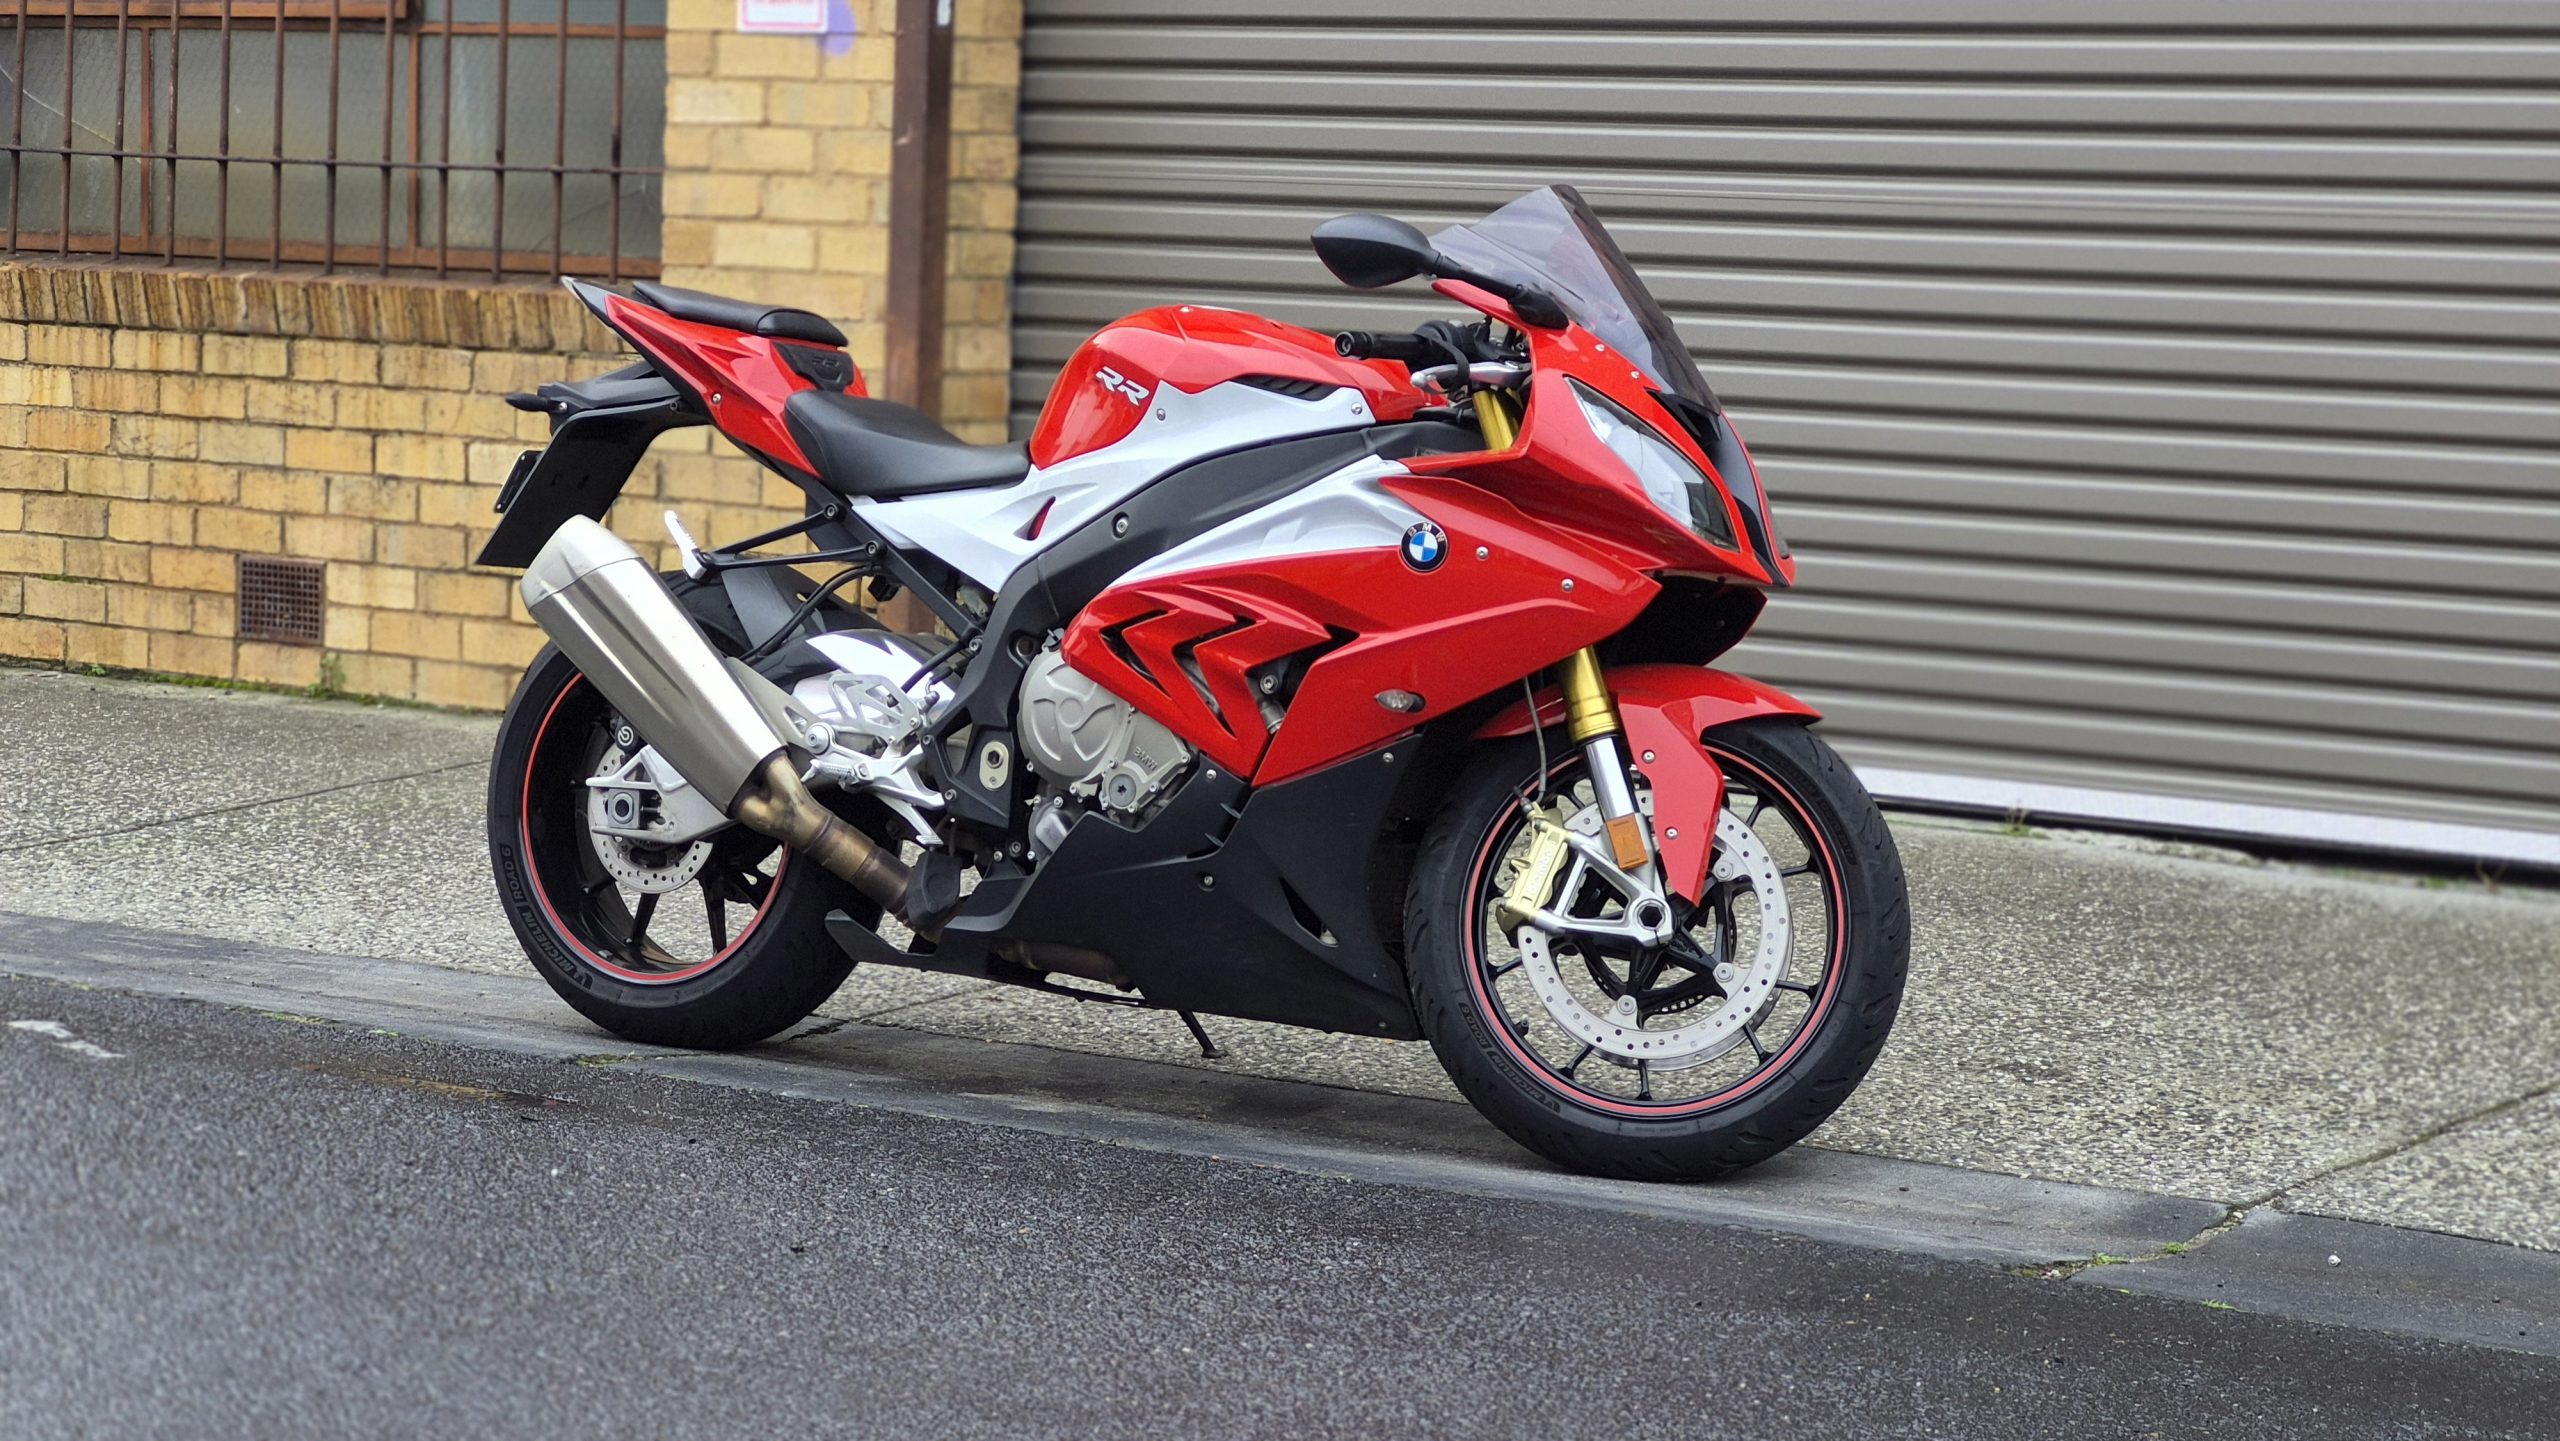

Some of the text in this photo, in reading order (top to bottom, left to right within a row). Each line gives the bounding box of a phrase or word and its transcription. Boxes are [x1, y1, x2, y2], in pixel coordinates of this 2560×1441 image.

[1095, 366, 1150, 406] RR
[1407, 522, 1445, 542] BMW
[505, 860, 525, 900] ROAD
[521, 911, 575, 977] MICHELIN
[1467, 1017, 1489, 1049] ROAD
[1492, 1055, 1544, 1099] MICHELIN
